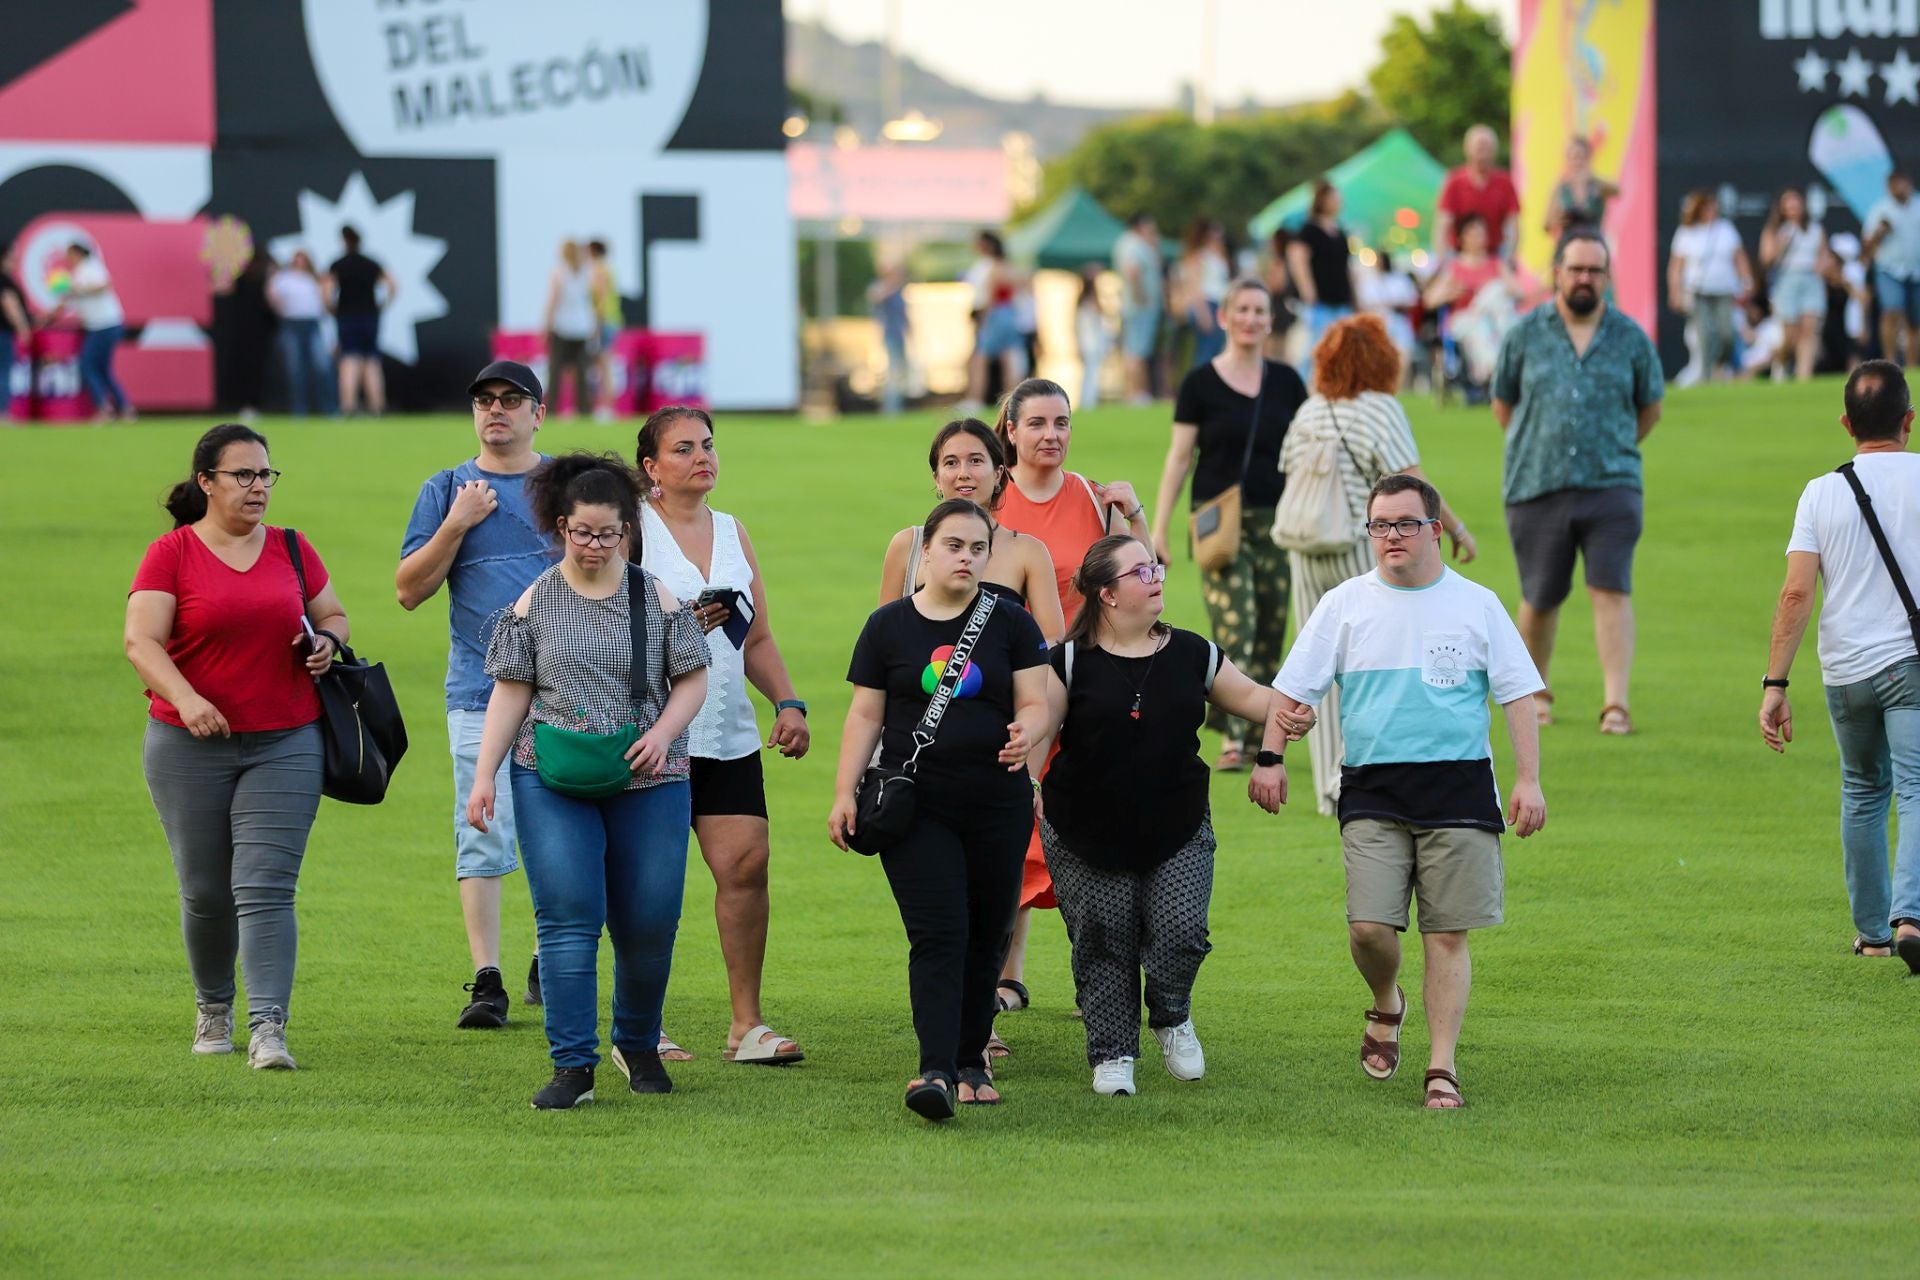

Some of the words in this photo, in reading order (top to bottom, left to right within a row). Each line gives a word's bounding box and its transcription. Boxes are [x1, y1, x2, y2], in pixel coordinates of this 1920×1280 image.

[384, 15, 486, 70] DEL
[391, 42, 653, 130] MALECÓN
[966, 595, 994, 633] BIMBA
[945, 643, 970, 677] LOLA
